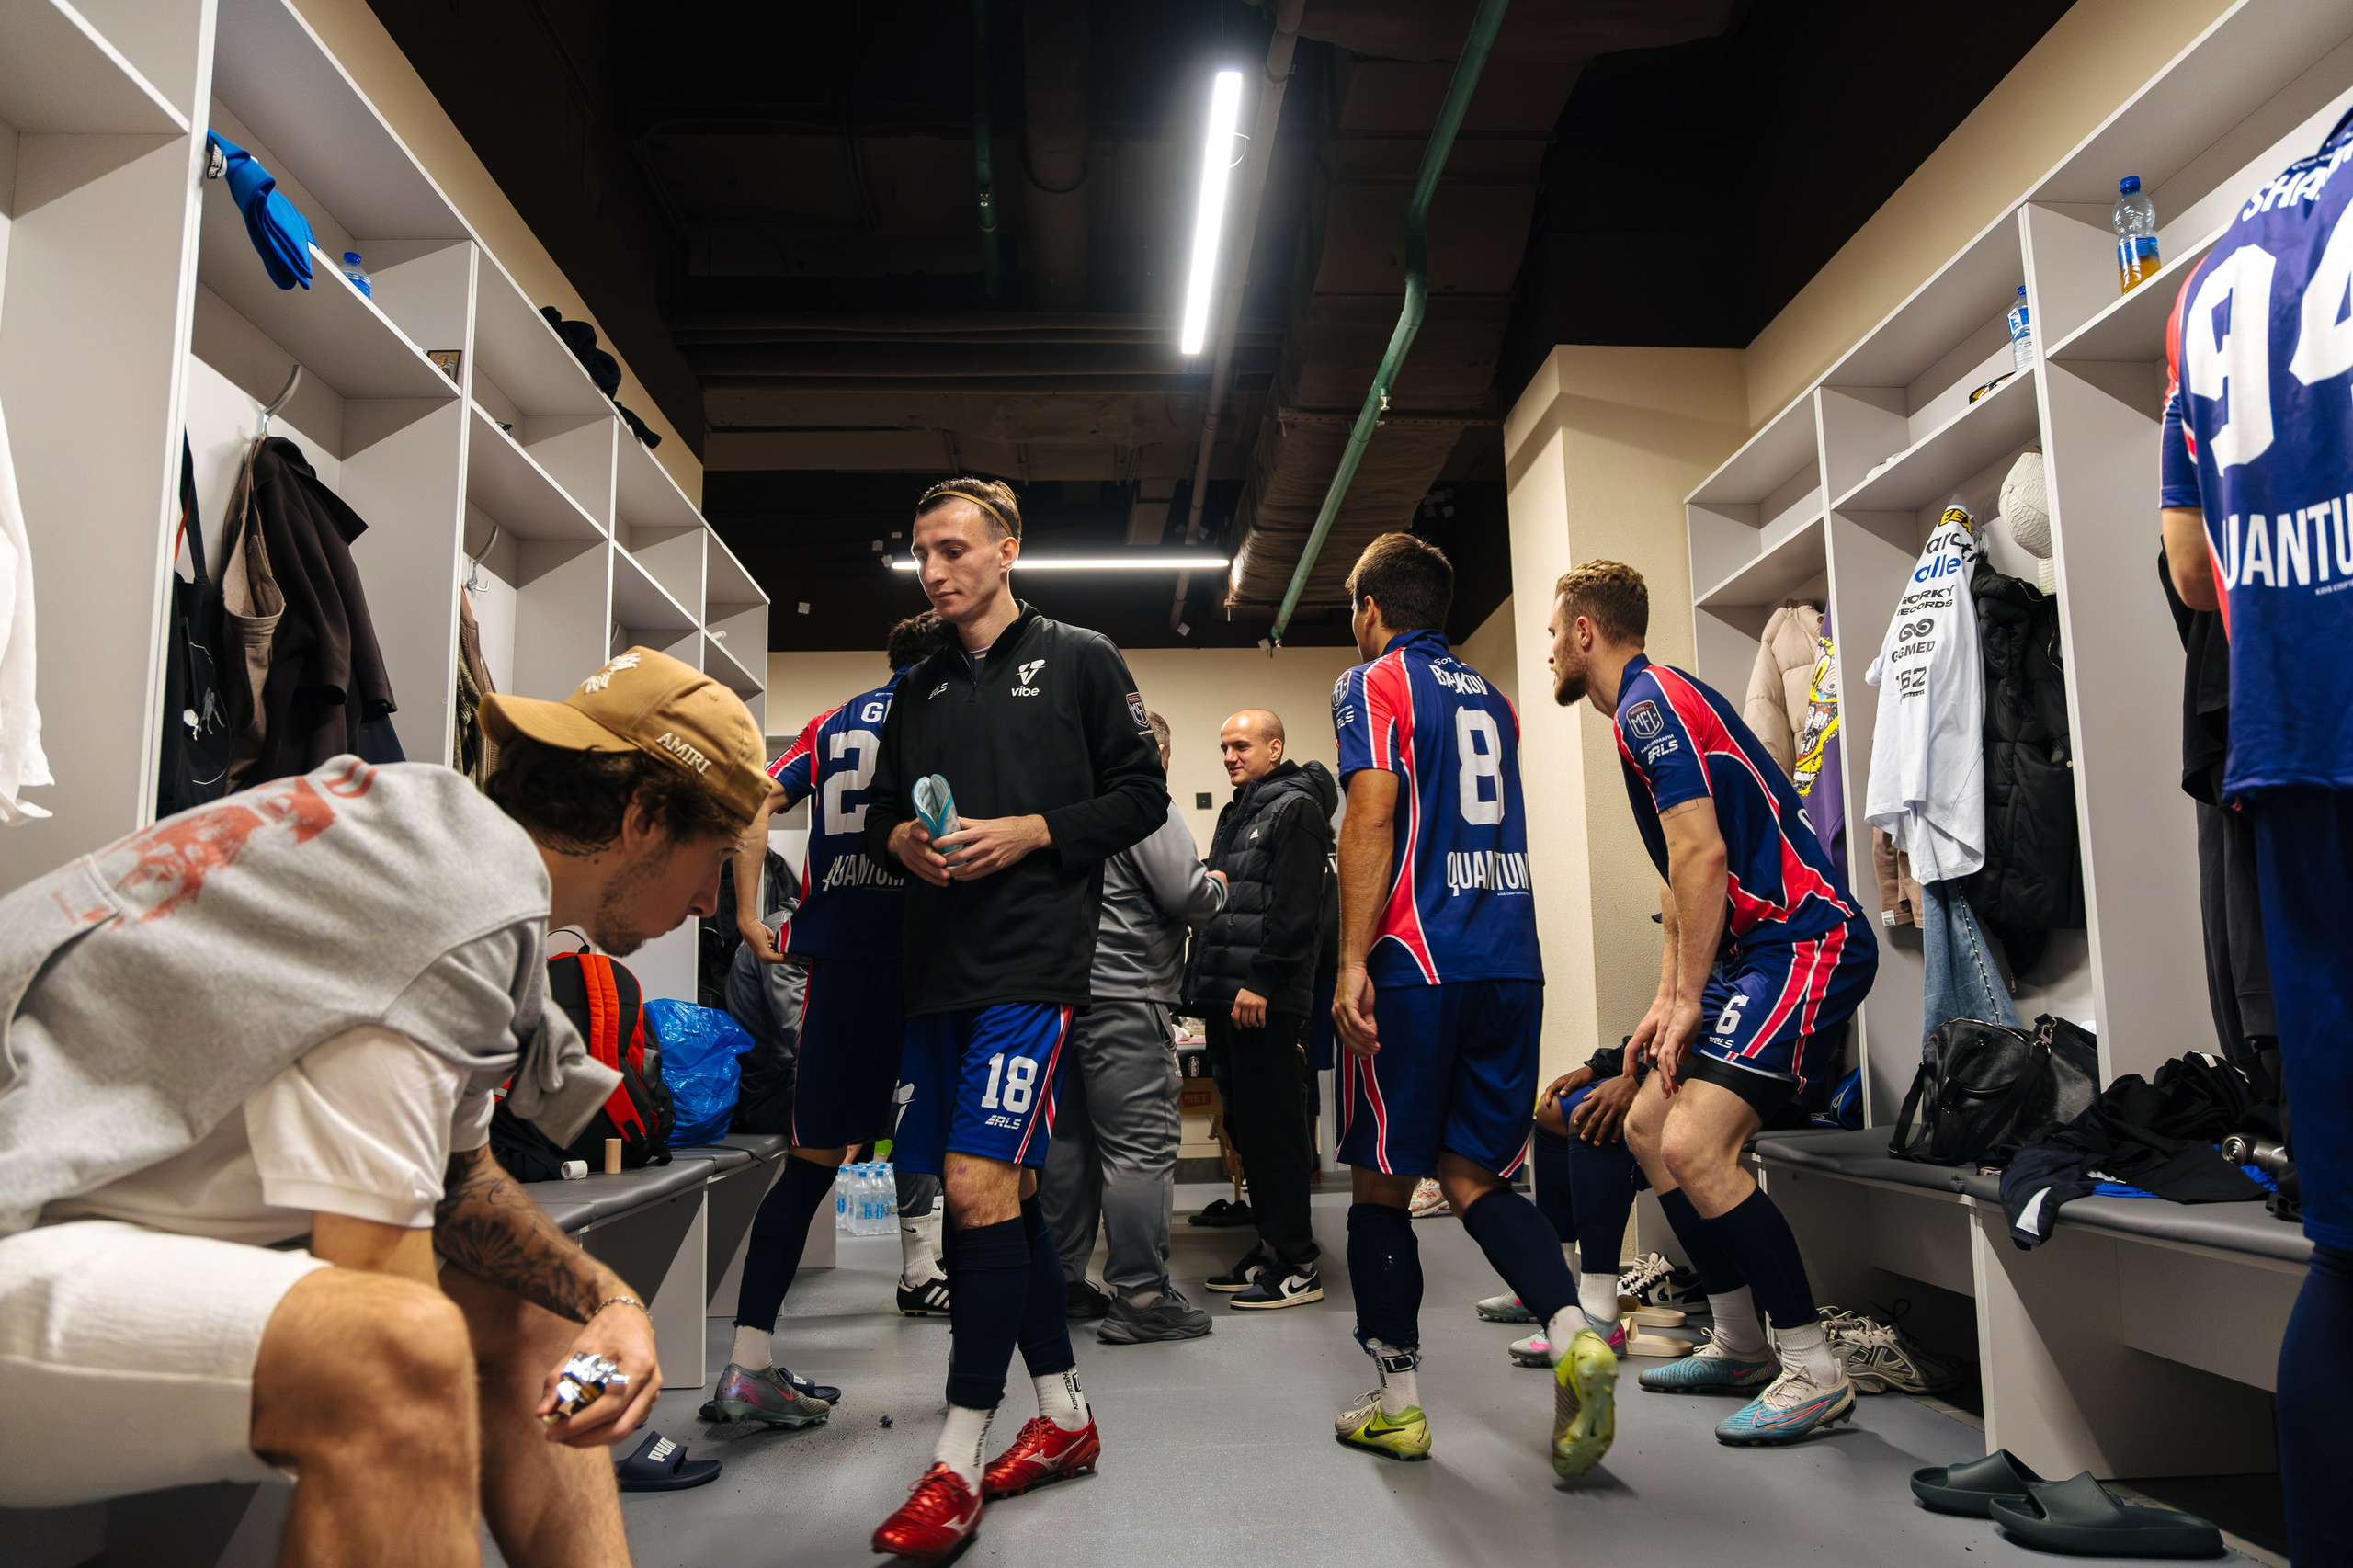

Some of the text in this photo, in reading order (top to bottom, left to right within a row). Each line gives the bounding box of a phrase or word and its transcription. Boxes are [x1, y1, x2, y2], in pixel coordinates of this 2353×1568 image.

[1011, 685, 1040, 697] vibe
[1631, 710, 1660, 735] MFL
[656, 732, 712, 775] AMIRI
[1455, 705, 1505, 826] 8
[824, 729, 881, 835] 2
[1715, 994, 1750, 1035] 6
[981, 1052, 1039, 1114] 18
